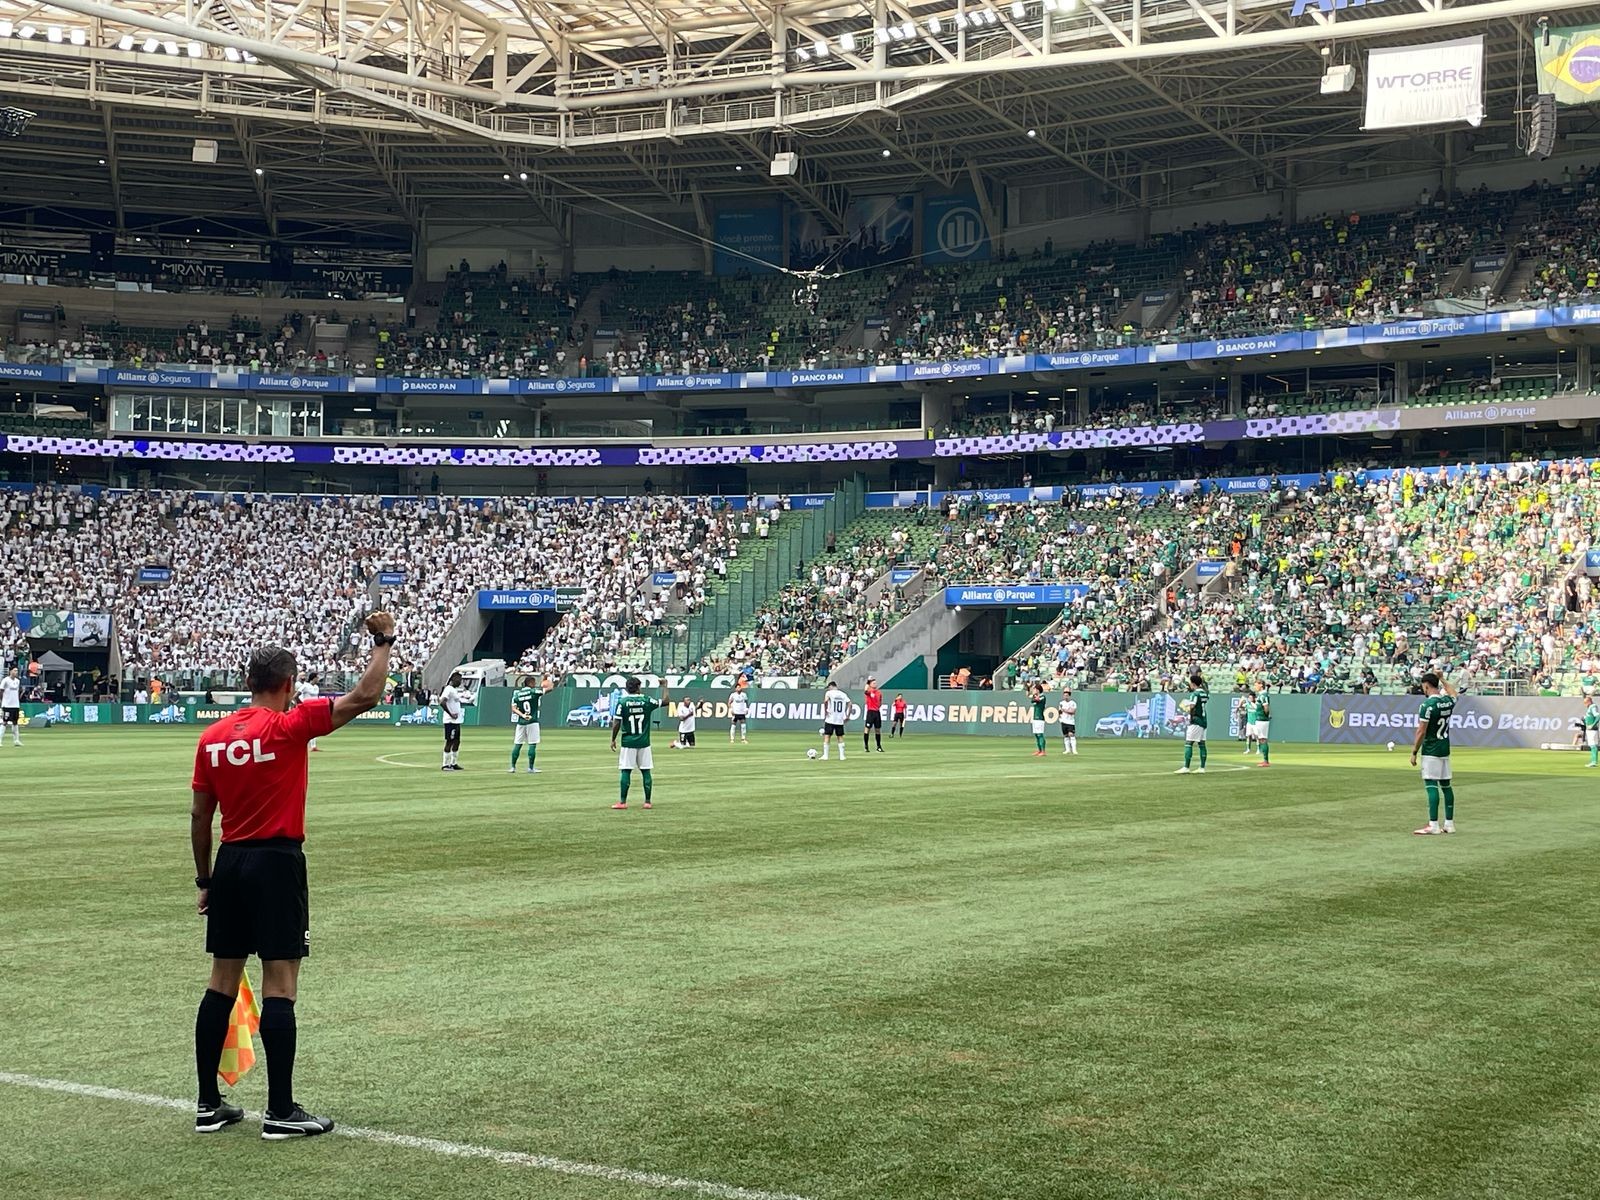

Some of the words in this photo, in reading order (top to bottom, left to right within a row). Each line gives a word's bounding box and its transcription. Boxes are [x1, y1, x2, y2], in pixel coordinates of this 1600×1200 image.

[1376, 66, 1472, 88] WTORRE
[162, 263, 224, 277] MIRANTE
[1383, 326, 1417, 336] Allianz
[1432, 322, 1465, 332] Parque
[1225, 342, 1256, 351] BANCO
[1257, 340, 1276, 348] PAN
[1050, 356, 1079, 366] Allianz
[1092, 353, 1119, 363] Parque
[0, 368, 22, 376] ANCO
[24, 369, 42, 377] PAN
[914, 367, 940, 376] Allianz
[953, 363, 981, 373] Seguros
[117, 372, 147, 381] Allianz
[161, 374, 191, 384] Seguros
[259, 377, 289, 386] Allianz
[302, 378, 329, 388] Parque
[656, 378, 684, 387] Allianz
[696, 378, 722, 387] Parque
[800, 374, 827, 382] BANCO
[828, 373, 844, 381] PAN
[528, 382, 555, 390] Allianz
[567, 382, 596, 391] Seguros
[1444, 409, 1483, 420] Allianz
[1500, 406, 1537, 418] Parque
[1228, 480, 1256, 489] Allianz
[984, 492, 1011, 501] Seguros
[1082, 487, 1108, 495] Allianz
[492, 594, 528, 604] Allianz
[961, 590, 993, 600] Allianz
[1006, 590, 1036, 602] Parque
[523, 701, 531, 714] 9
[746, 702, 787, 719] MEIO
[948, 705, 978, 723] EM
[833, 701, 843, 713] 10
[197, 710, 220, 719] MAIS
[628, 714, 645, 734] 17
[1497, 713, 1562, 730] Betano
[205, 738, 276, 768] TCL
